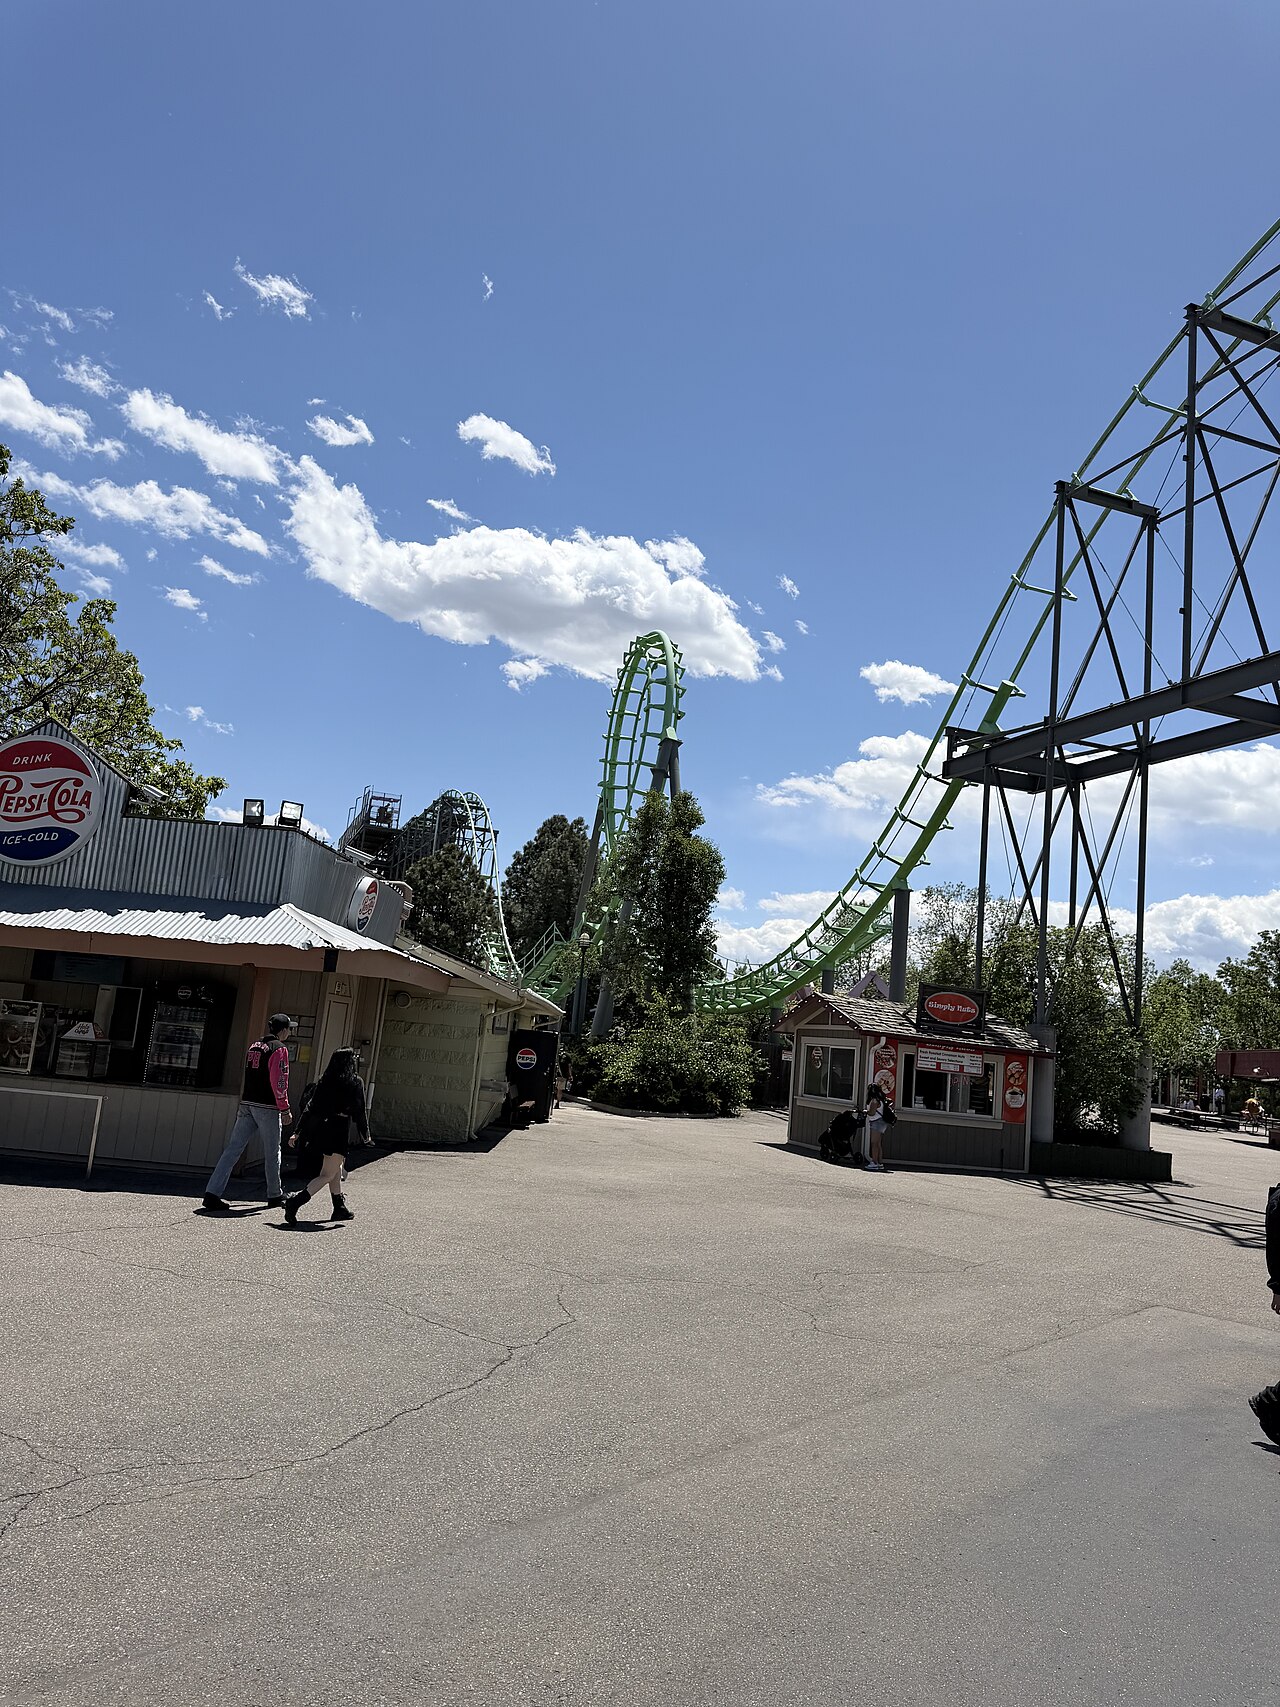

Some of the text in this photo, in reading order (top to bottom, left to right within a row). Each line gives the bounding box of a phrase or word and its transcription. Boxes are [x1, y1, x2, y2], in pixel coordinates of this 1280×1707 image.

[13, 753, 52, 765] DRINK
[2, 832, 59, 845] ICE-COLD
[928, 1001, 976, 1014] Simply Nuts
